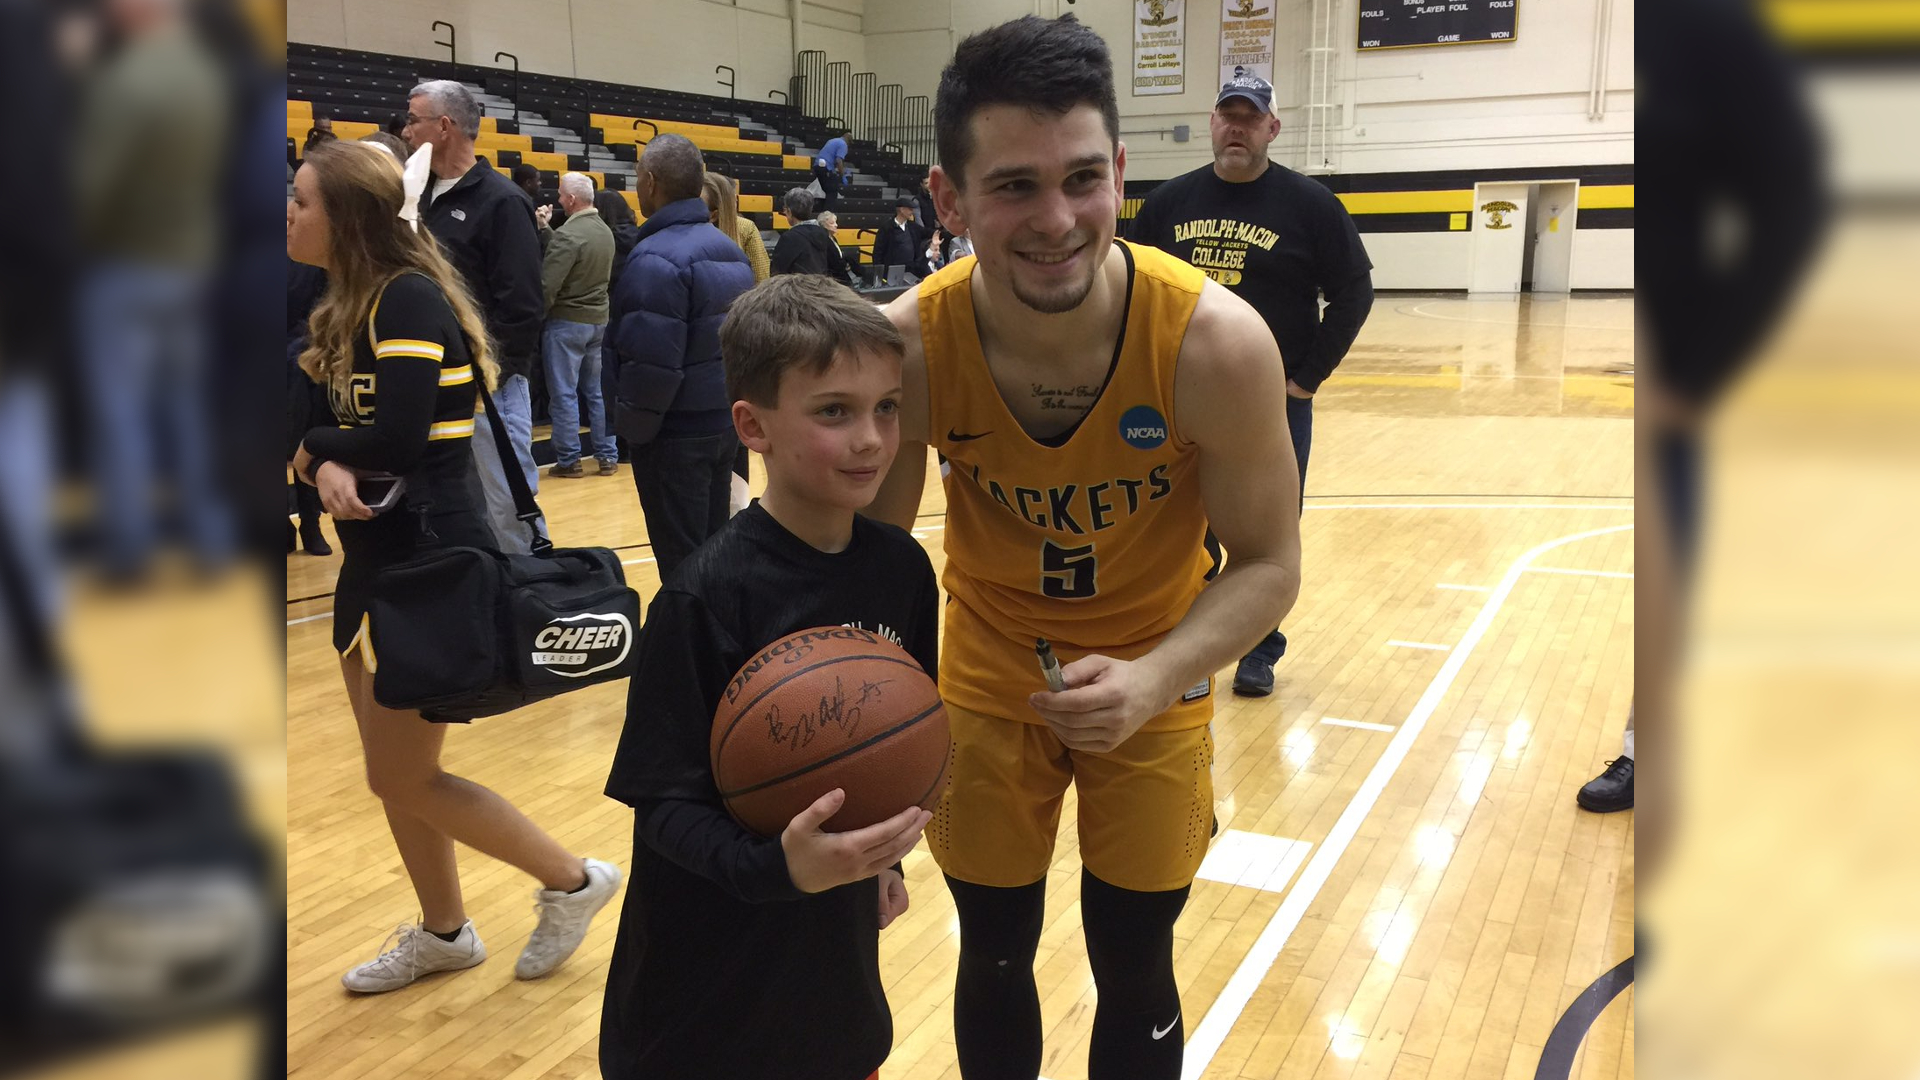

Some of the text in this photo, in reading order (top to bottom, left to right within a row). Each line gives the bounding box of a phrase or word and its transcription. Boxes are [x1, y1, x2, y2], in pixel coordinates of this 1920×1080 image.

[1416, 4, 1469, 14] PLAYER FOUL
[1489, 1, 1514, 9] FOULS
[1361, 10, 1384, 18] FOULS
[1438, 34, 1460, 42] GAME
[1491, 31, 1510, 39] WON
[1362, 40, 1381, 48] WON
[1157, 52, 1177, 60] Coach
[1154, 75, 1182, 86] WINS
[1196, 239, 1249, 250] YELLOW JACKETS
[1191, 246, 1247, 270] COLLEGE
[1127, 427, 1166, 439] NCAA
[1040, 538, 1098, 599] 5
[534, 624, 623, 650] CHEER
[536, 655, 582, 663] LEADER
